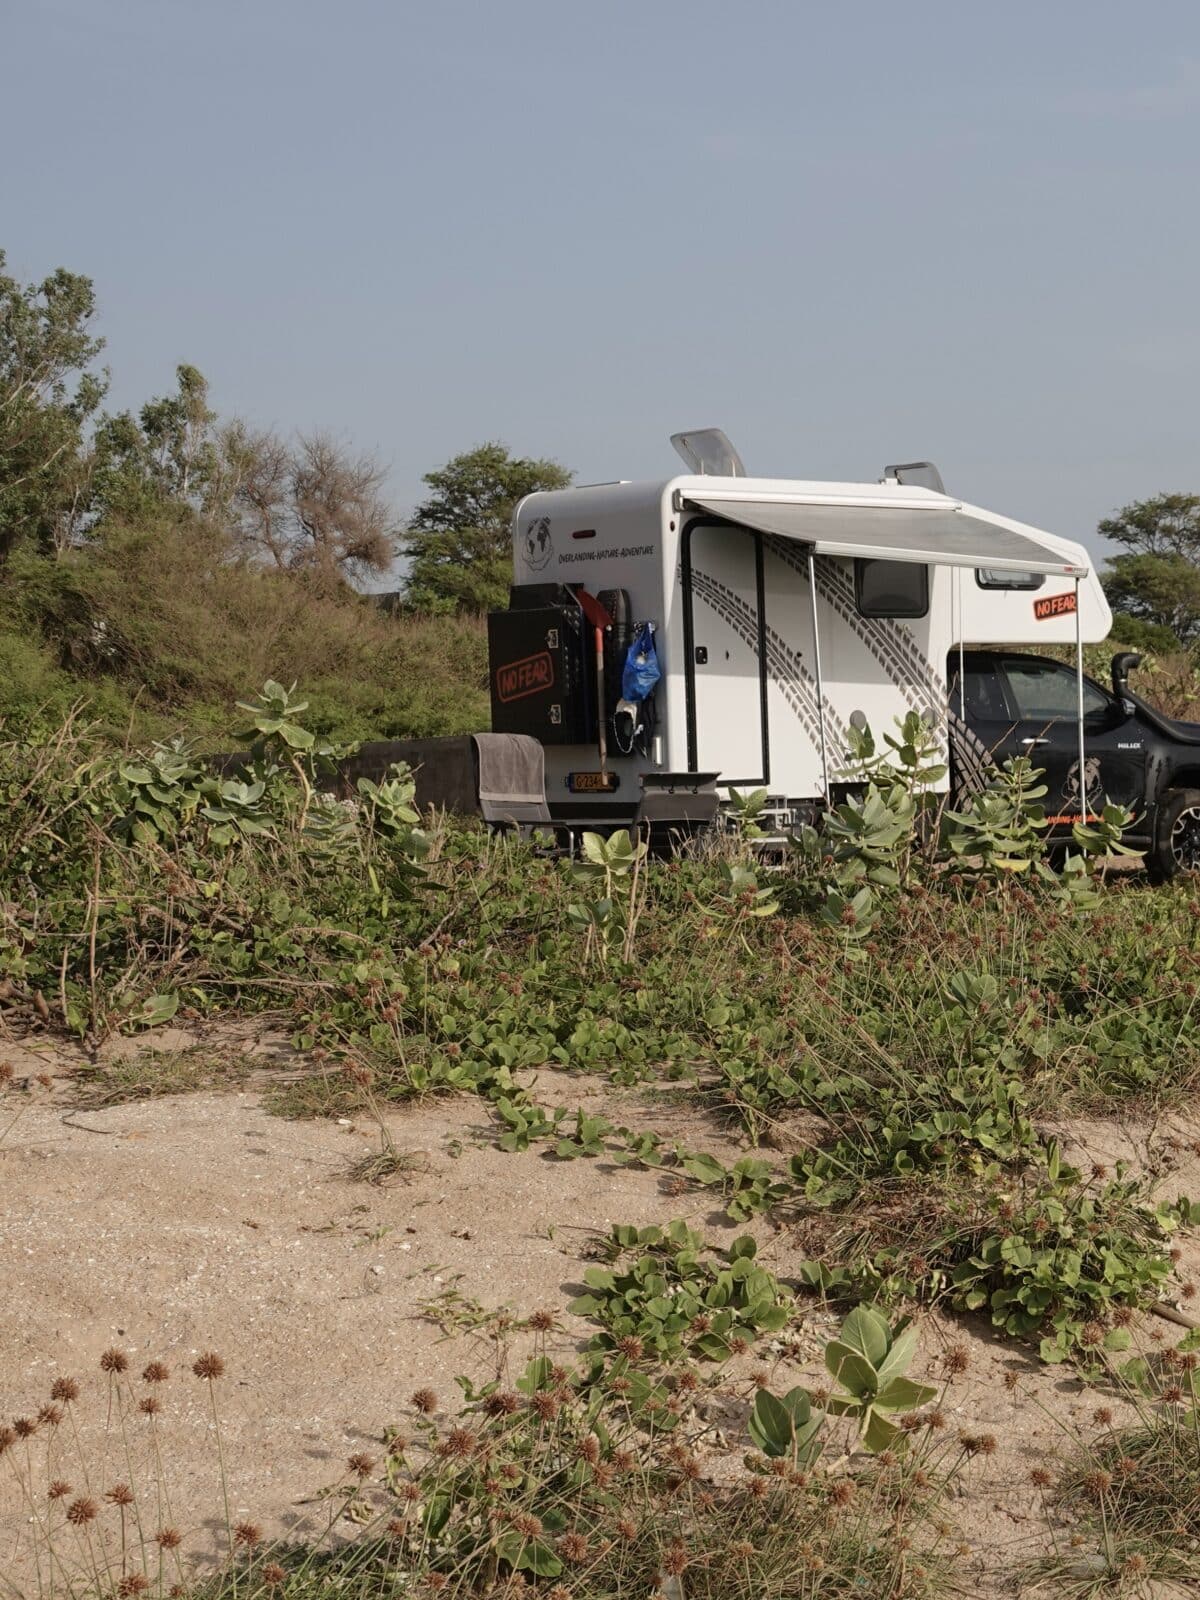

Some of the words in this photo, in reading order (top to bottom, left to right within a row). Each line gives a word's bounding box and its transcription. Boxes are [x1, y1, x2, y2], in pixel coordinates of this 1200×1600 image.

[1037, 601, 1051, 617] NO
[1051, 594, 1077, 614] FEAR
[502, 669, 518, 696] NO
[518, 658, 549, 689] FEAR
